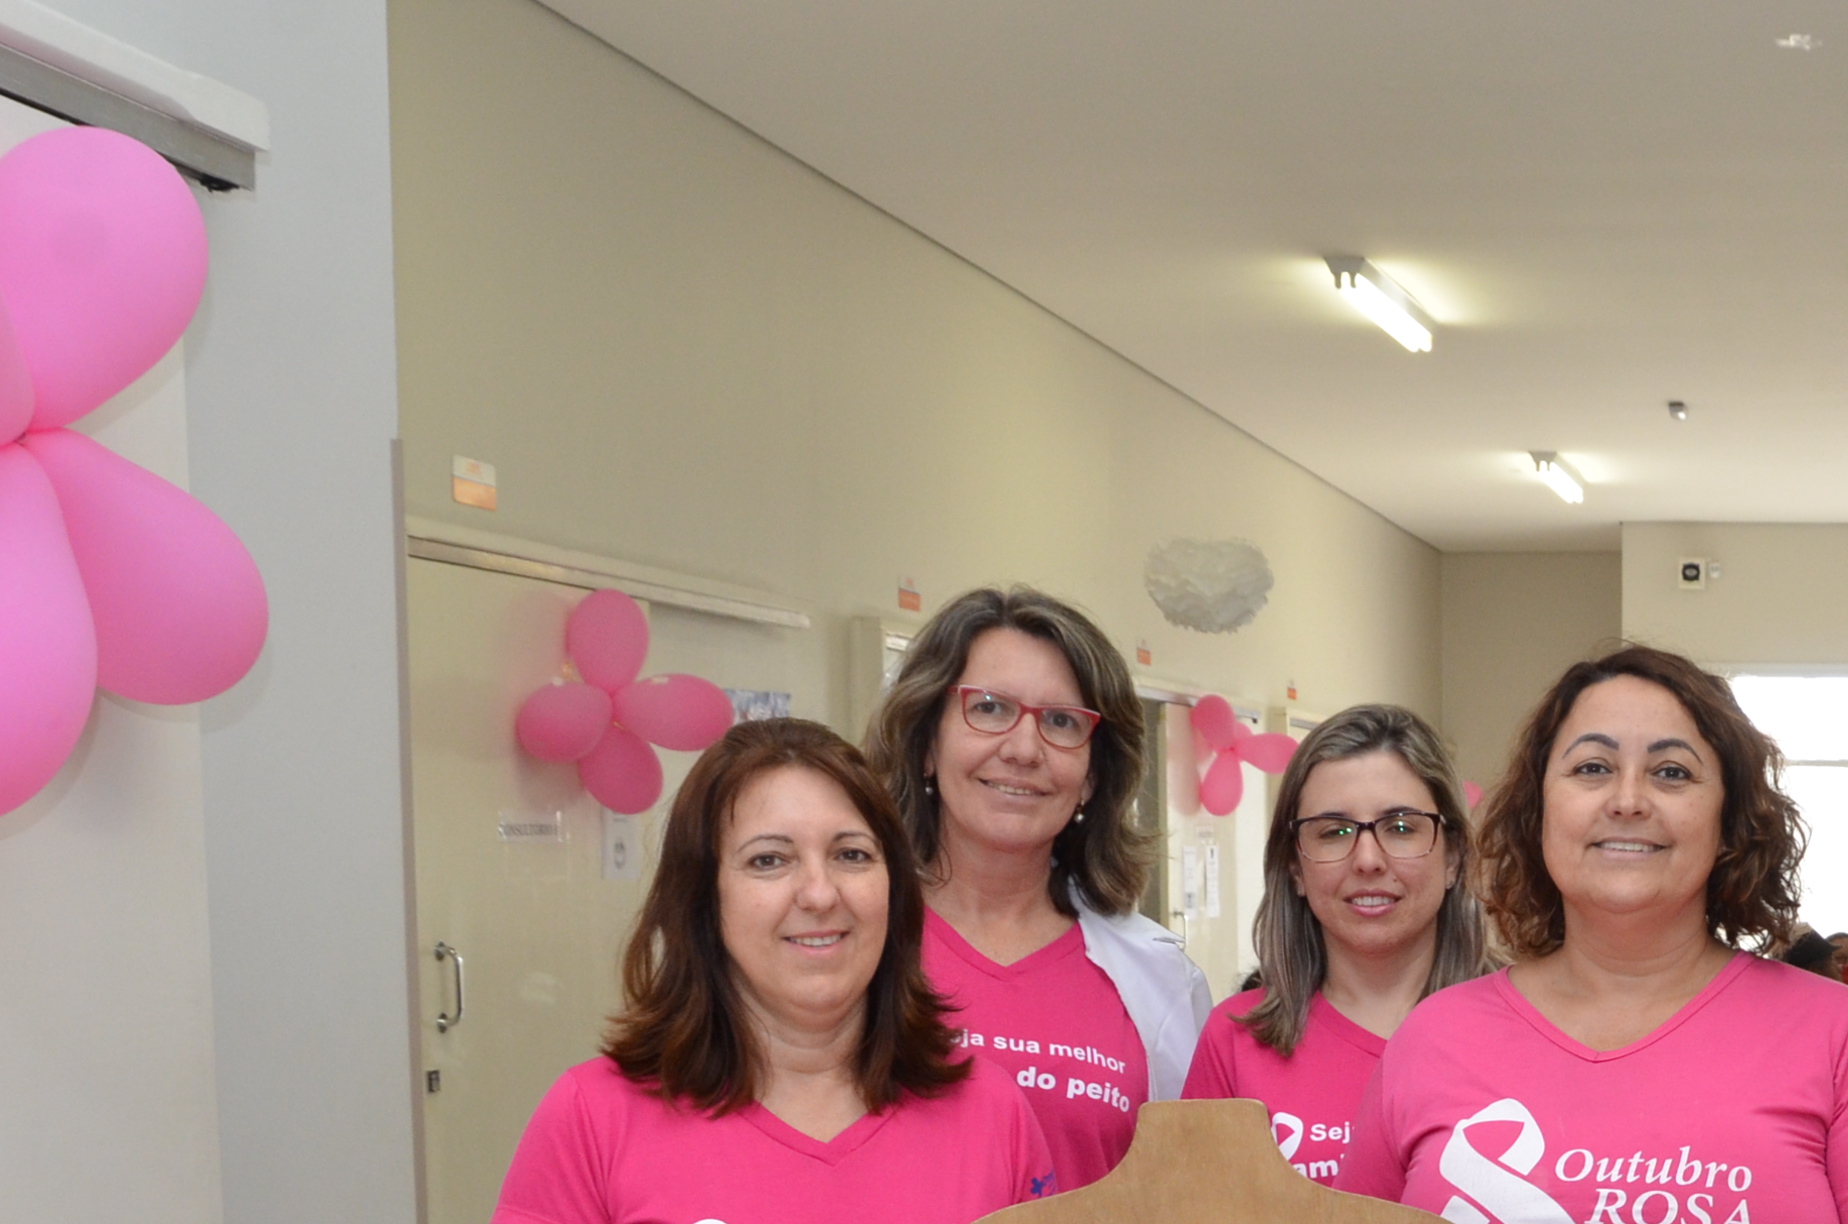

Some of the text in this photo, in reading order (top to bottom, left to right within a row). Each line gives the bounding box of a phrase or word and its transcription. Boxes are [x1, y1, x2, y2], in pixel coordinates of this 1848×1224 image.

[994, 1037, 1040, 1053] sua
[1049, 1044, 1126, 1074] melhor
[1016, 1066, 1129, 1112] do peito
[1310, 1121, 1354, 1144] Sej
[1292, 1154, 1345, 1178] am
[1554, 1145, 1752, 1192] Outubro
